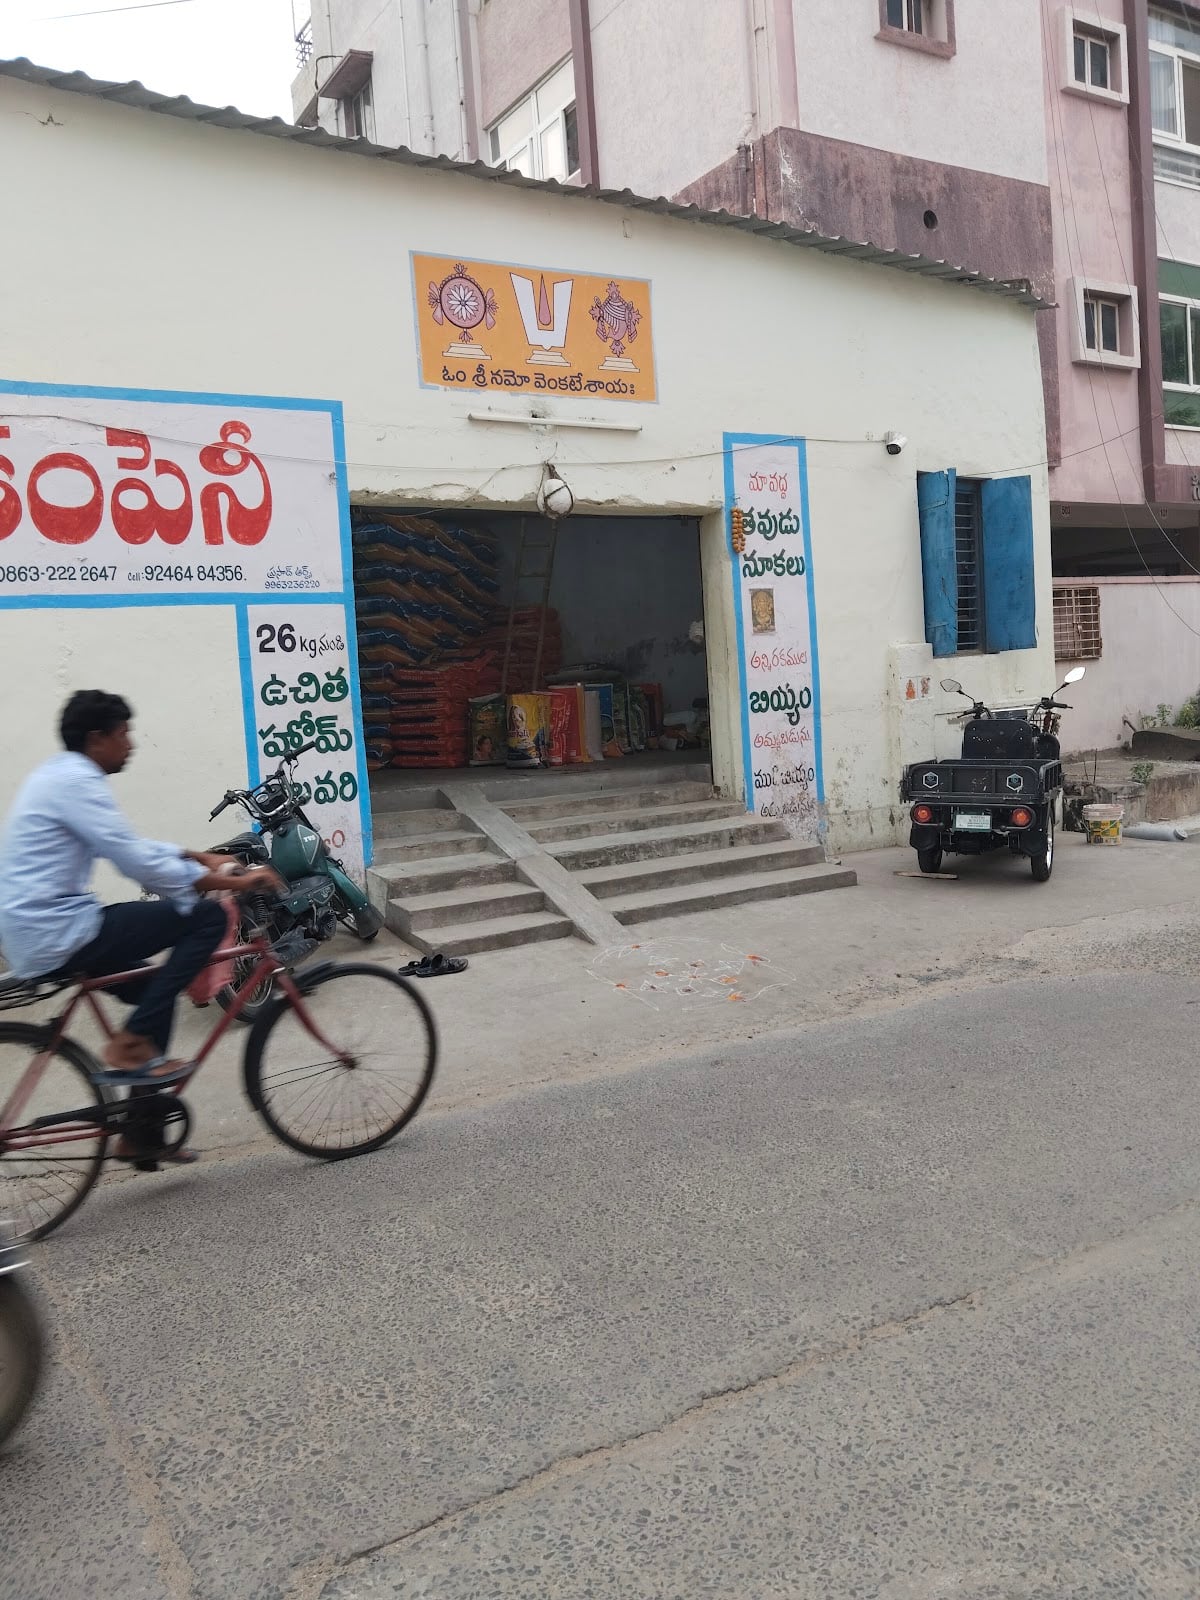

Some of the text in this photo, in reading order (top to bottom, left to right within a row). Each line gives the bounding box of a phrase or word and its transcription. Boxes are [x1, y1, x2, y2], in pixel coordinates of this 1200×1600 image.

[442, 366, 466, 382] ఓం
[472, 364, 487, 387] శ్రీ
[490, 369, 530, 387] నమో
[742, 507, 800, 541] తవుడు
[80, 566, 117, 581] 2647
[742, 549, 805, 578] నూకలు
[256, 623, 296, 653] 26
[261, 667, 349, 705] ఉచిత
[750, 683, 812, 726] బియ్యం
